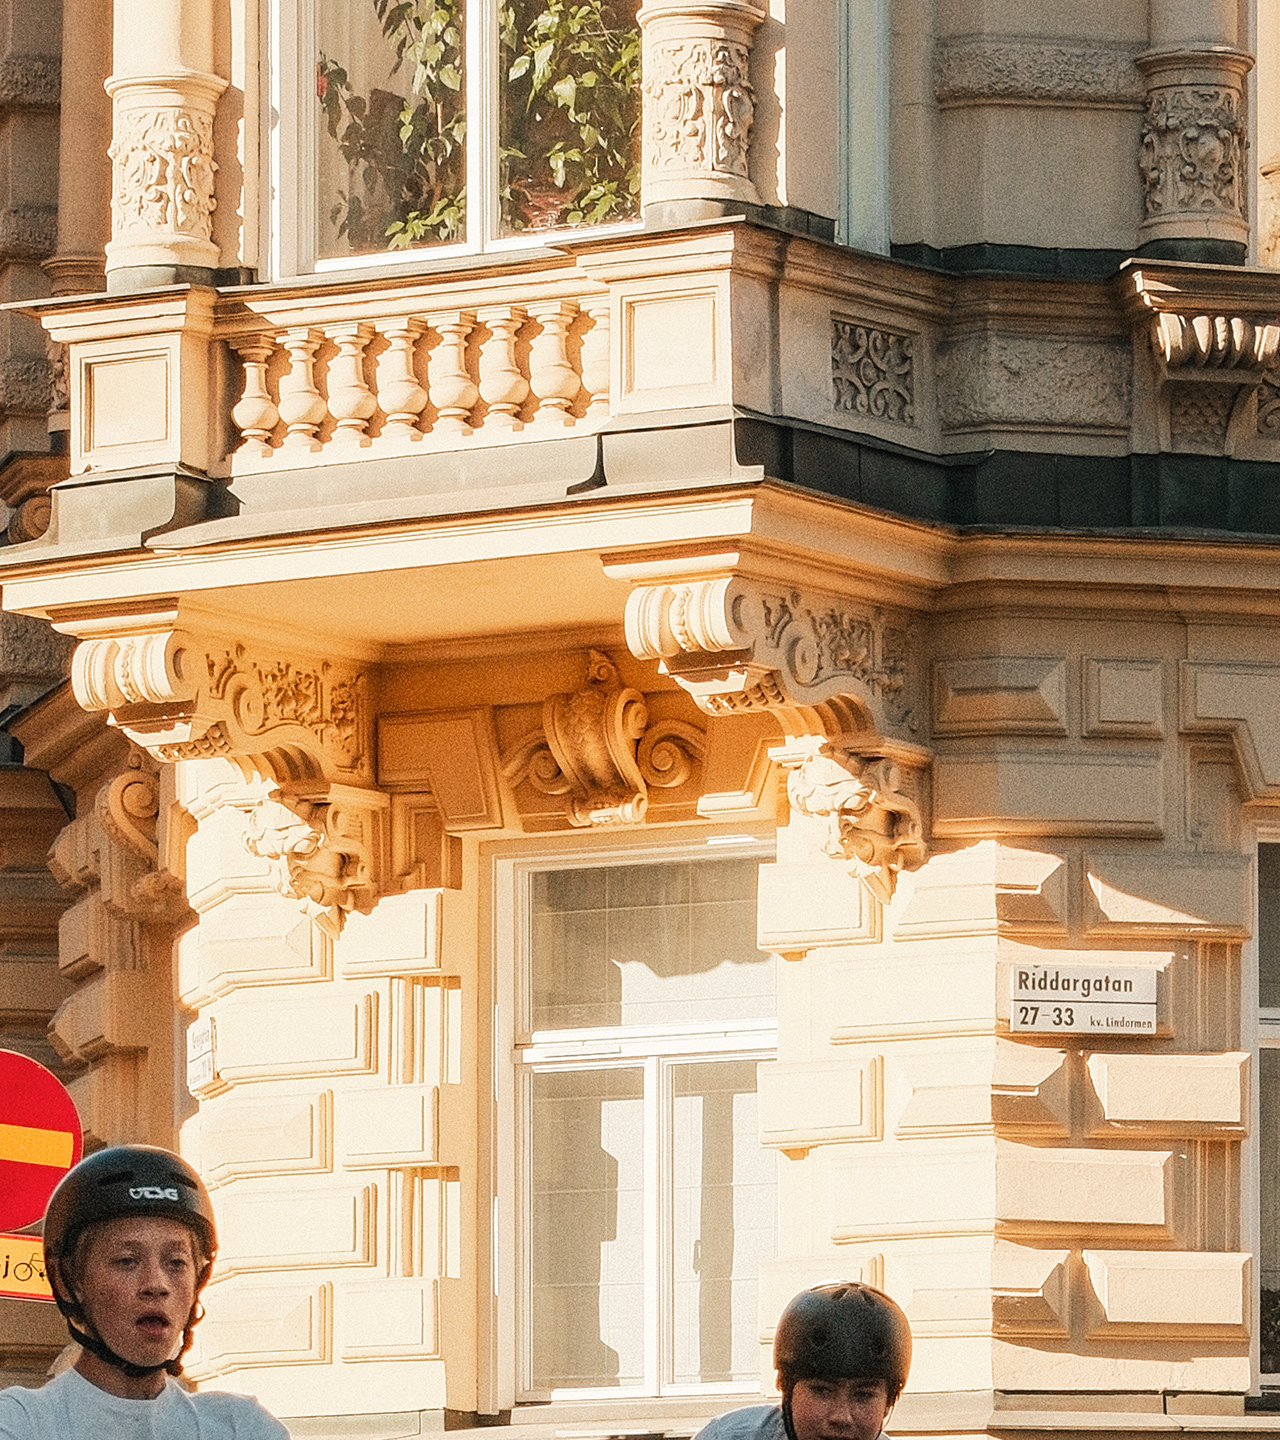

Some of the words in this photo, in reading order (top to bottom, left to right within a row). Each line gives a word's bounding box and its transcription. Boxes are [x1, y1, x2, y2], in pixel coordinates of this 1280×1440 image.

[1018, 970, 1133, 998] Riddargatan
[1090, 1015, 1104, 1027] kv.
[1106, 1016, 1153, 1029] Lindormen
